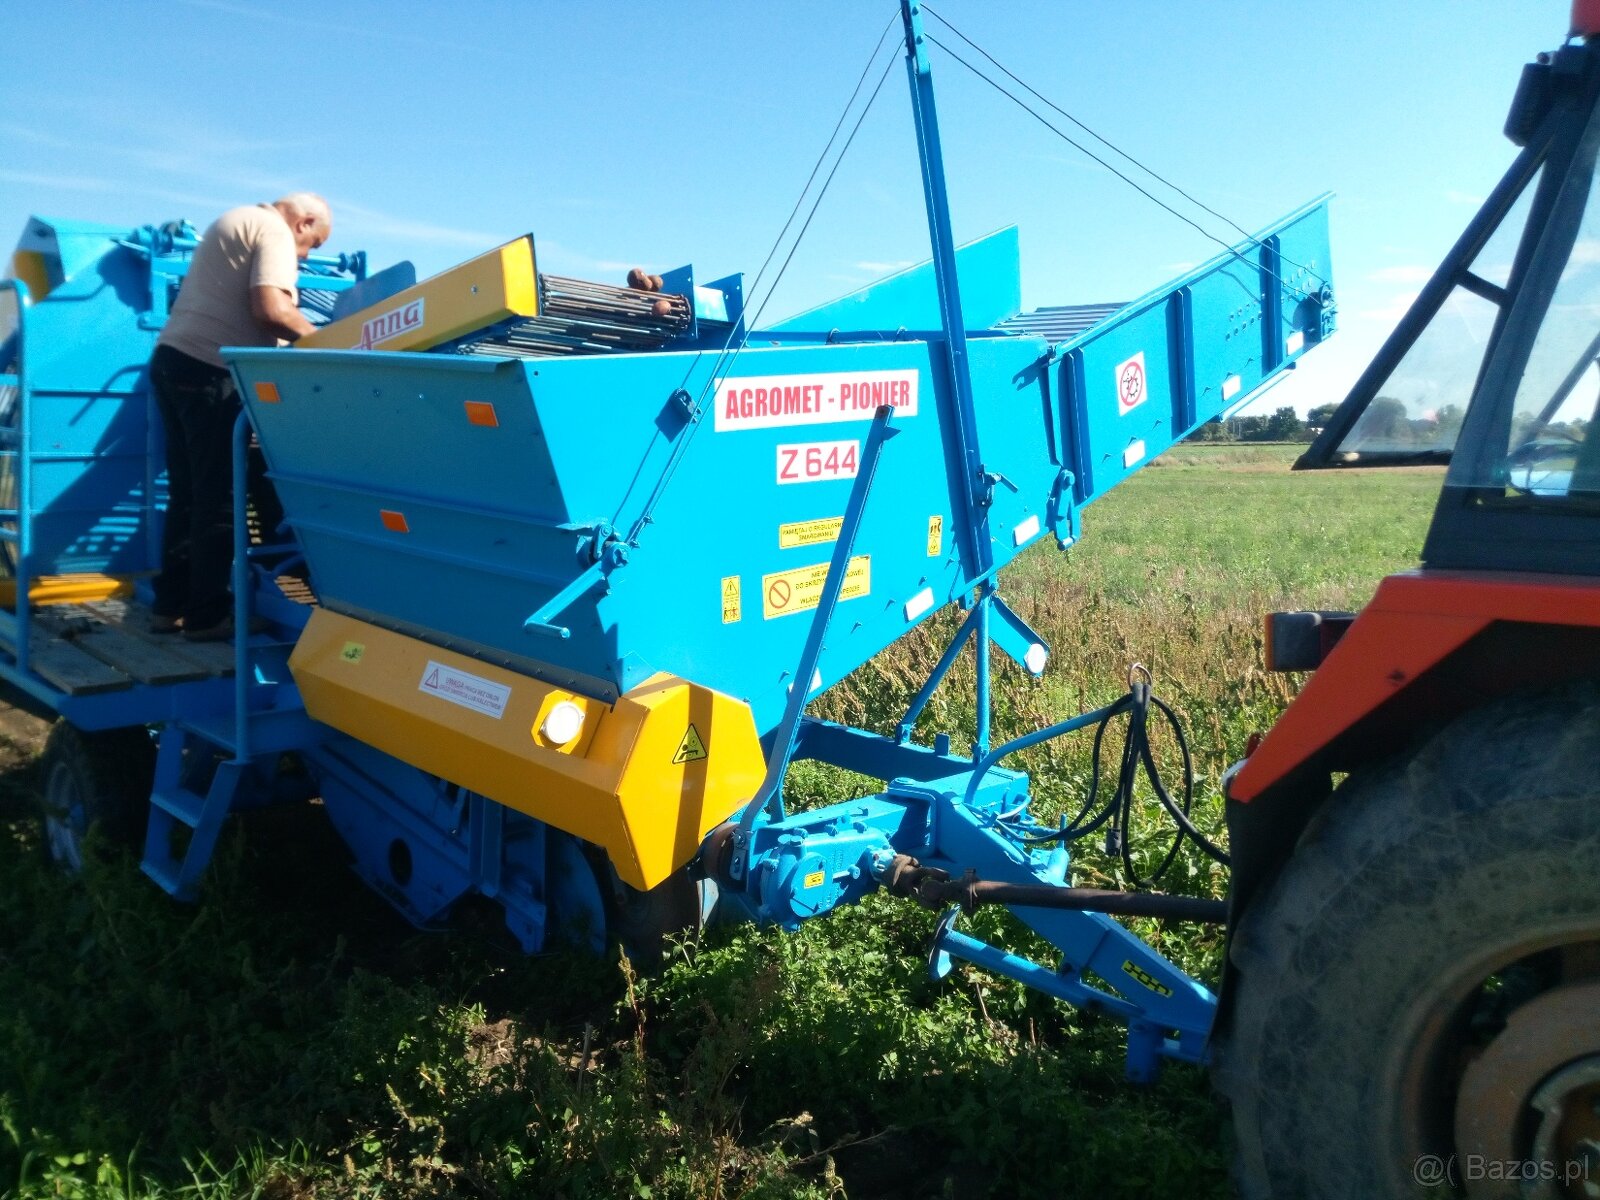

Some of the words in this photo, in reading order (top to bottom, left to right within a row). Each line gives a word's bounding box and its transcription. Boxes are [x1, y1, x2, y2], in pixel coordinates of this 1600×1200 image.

[360, 302, 420, 350] Anna
[725, 385, 823, 420] AGROMET
[840, 380, 910, 411] PIONIER
[780, 449, 799, 480] Z
[805, 445, 856, 477] 644
